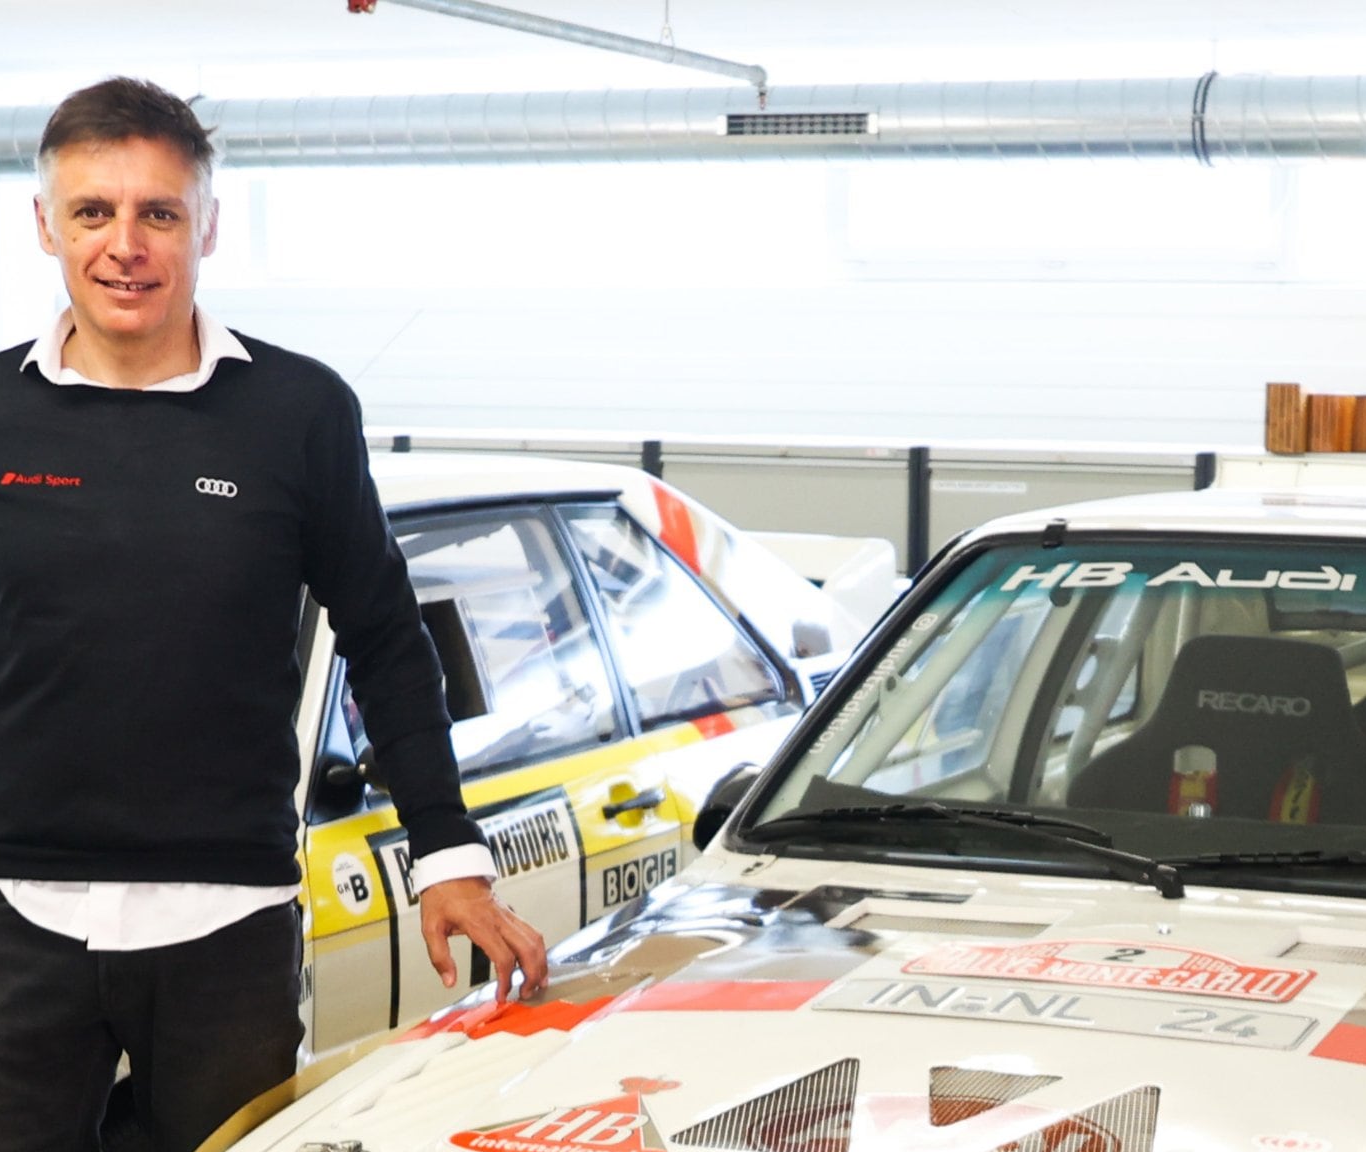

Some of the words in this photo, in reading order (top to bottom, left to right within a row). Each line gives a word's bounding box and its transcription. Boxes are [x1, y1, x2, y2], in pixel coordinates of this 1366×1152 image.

[15, 473, 43, 485] Audi
[45, 473, 82, 487] Sport
[999, 561, 1135, 593] HB
[1147, 562, 1355, 593] Audi
[1198, 690, 1311, 716] RECARO
[350, 874, 369, 903] B
[604, 849, 676, 906] BOGE
[1103, 947, 1146, 962] 2
[1157, 1008, 1263, 1040] 24
[515, 1106, 649, 1146] HB
